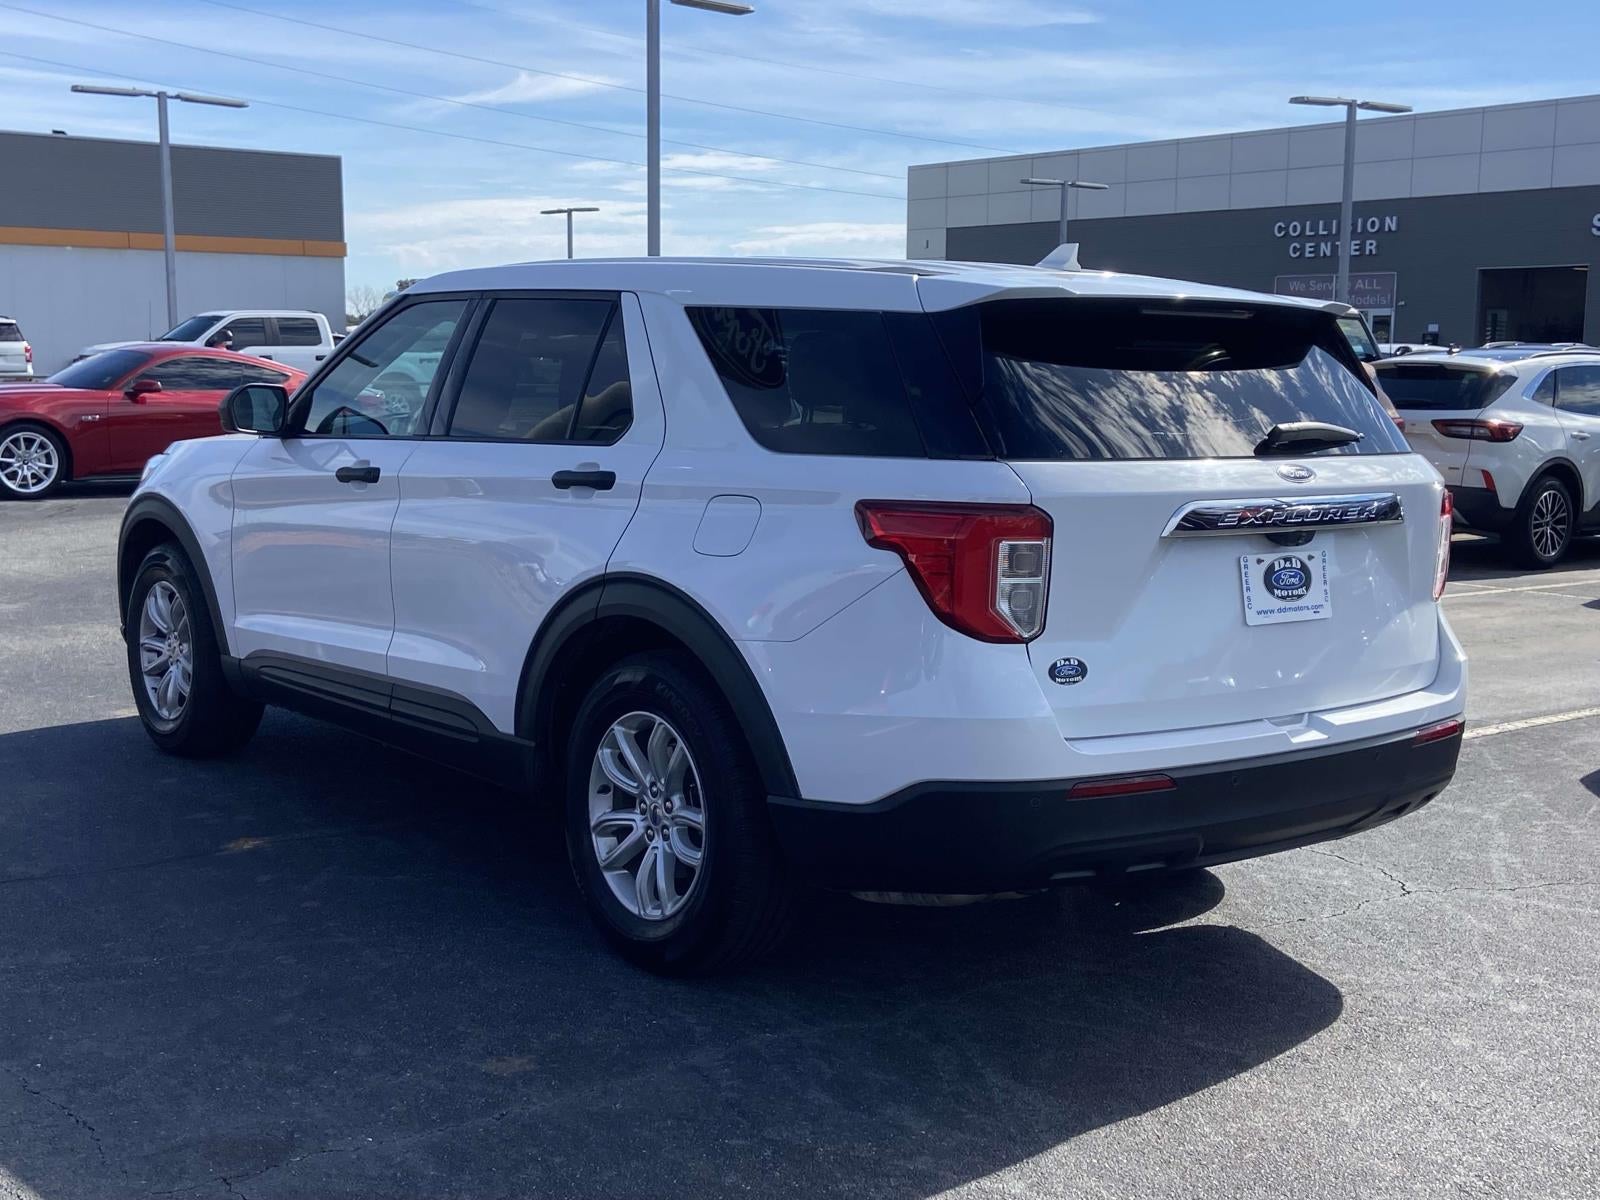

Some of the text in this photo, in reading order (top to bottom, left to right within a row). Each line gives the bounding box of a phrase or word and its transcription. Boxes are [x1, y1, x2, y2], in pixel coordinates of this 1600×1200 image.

[1274, 216, 1398, 237] COLLIION
[1289, 281, 1306, 291] We
[1355, 279, 1382, 290] ALL
[1218, 502, 1379, 525] EXPLORER
[1273, 558, 1302, 571] D&D
[1279, 571, 1300, 586] Ford
[1273, 586, 1307, 597] MOTORS
[1256, 604, 1324, 616] www.ddmotors.com
